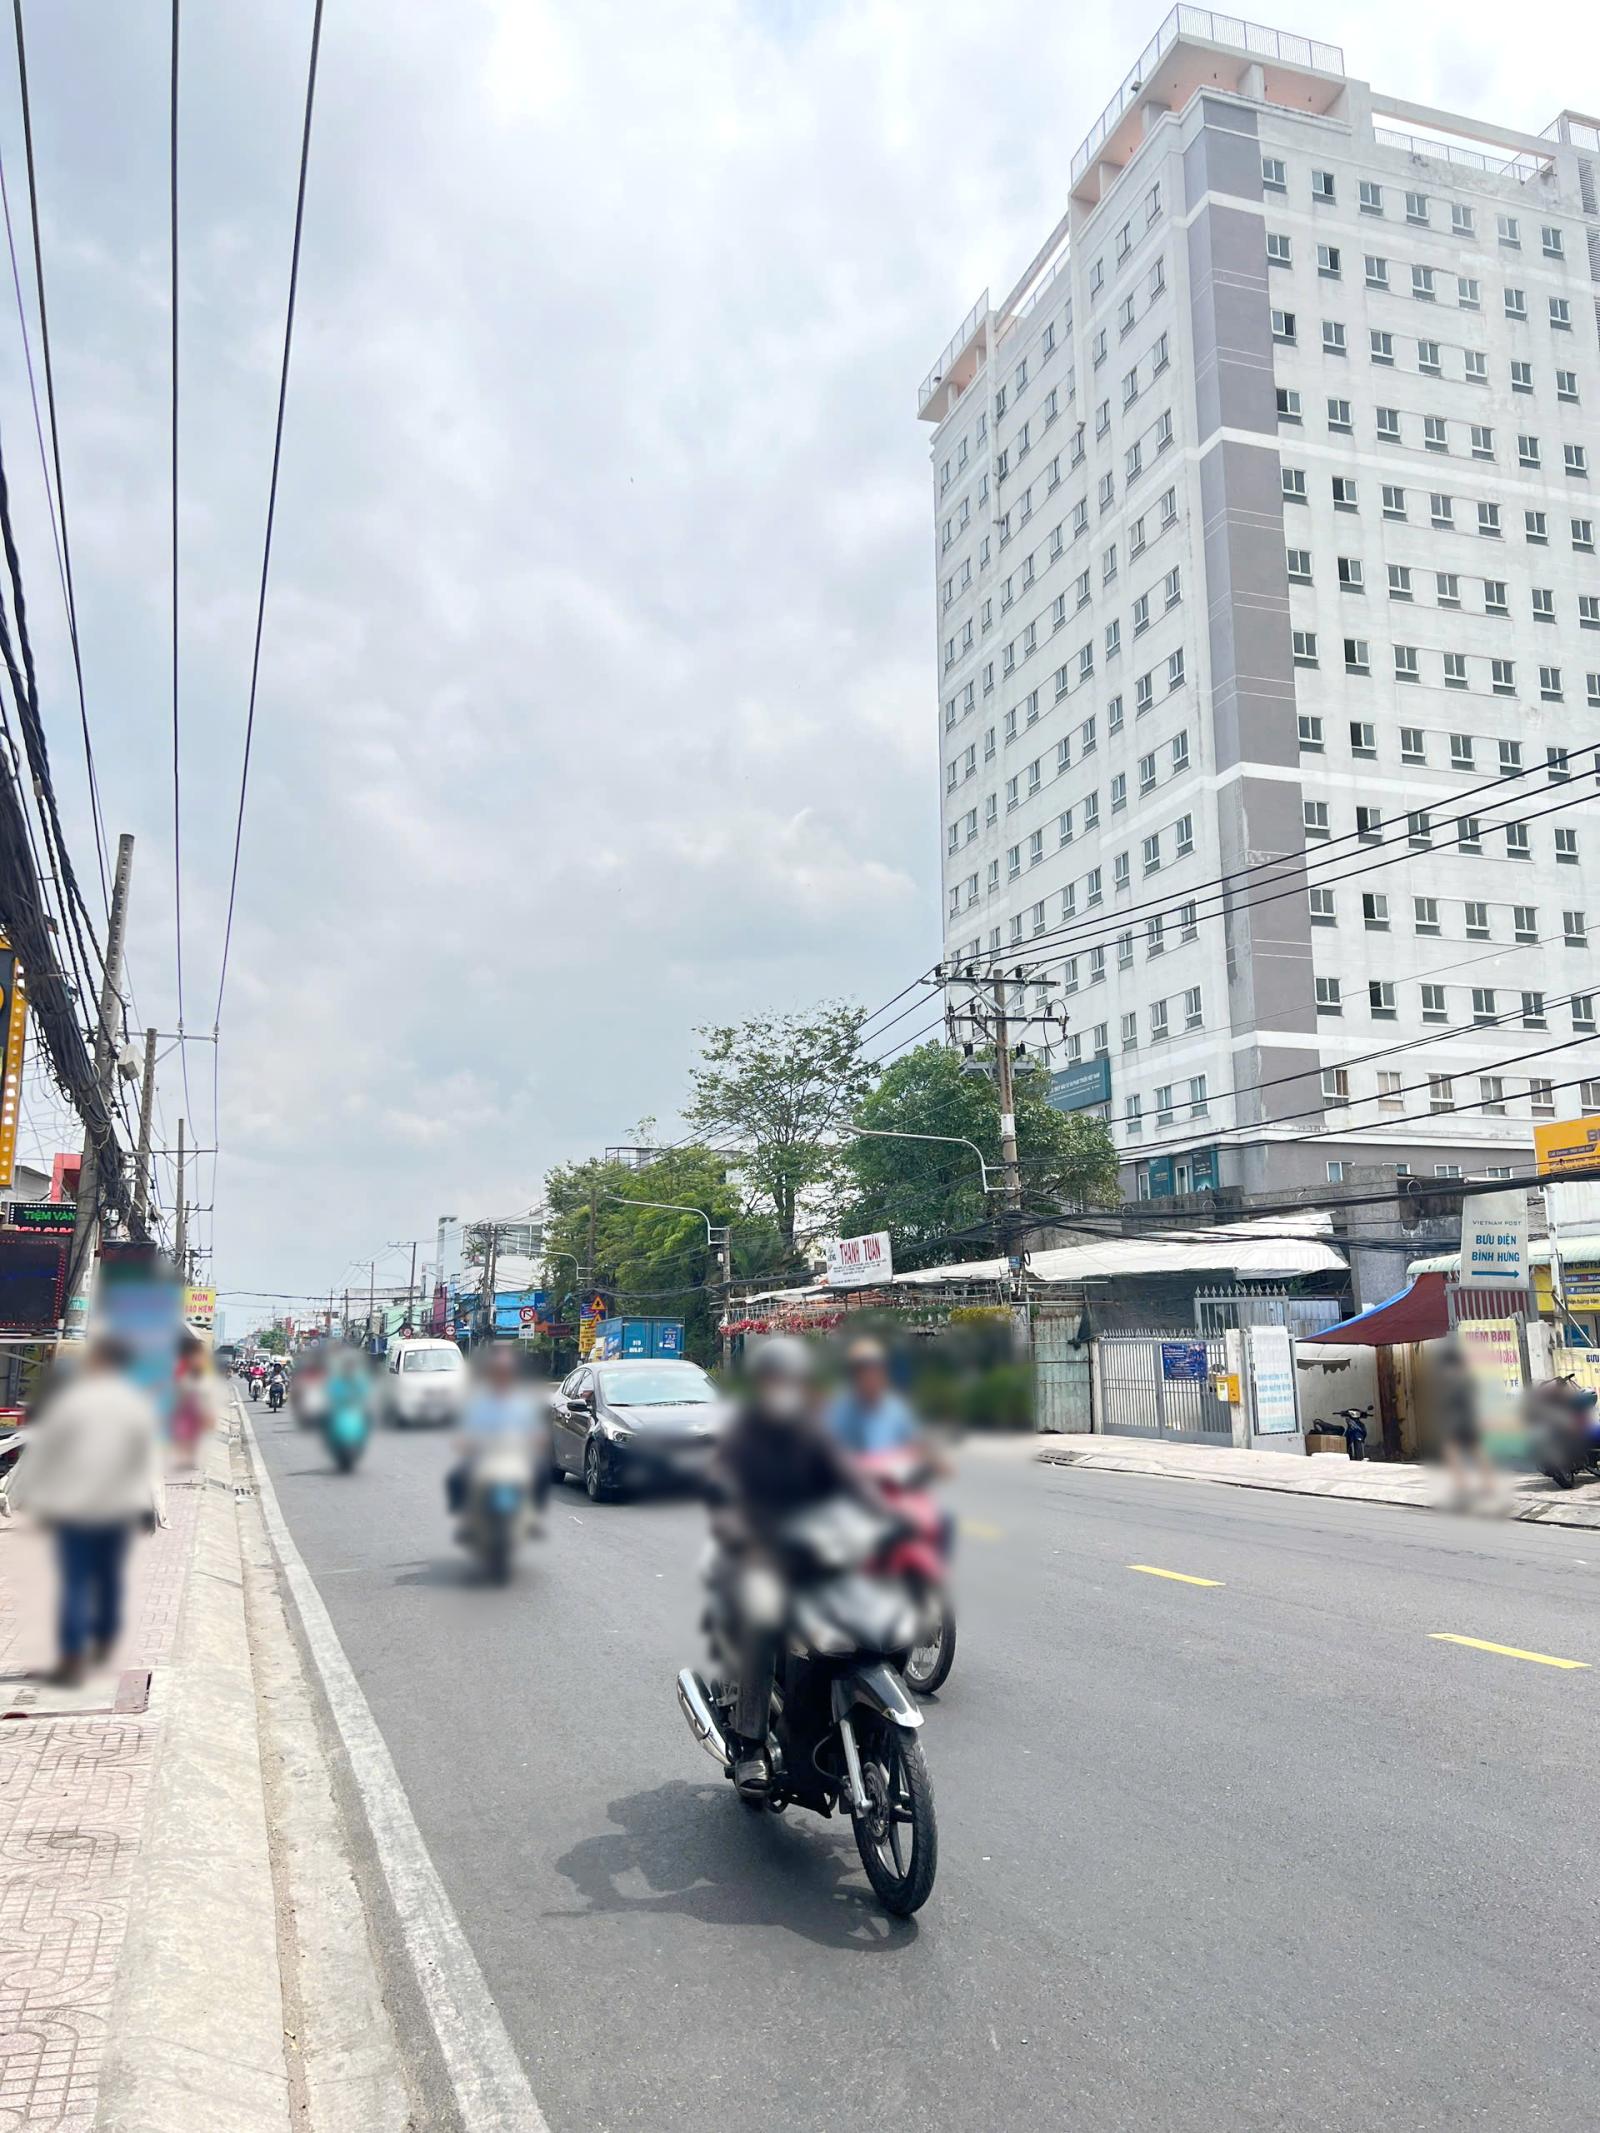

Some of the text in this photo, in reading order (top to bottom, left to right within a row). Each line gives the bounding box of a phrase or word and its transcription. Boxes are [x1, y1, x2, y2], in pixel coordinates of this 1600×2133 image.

[1475, 1233, 1517, 1246] BƯU ĐIỆN
[1471, 1249, 1520, 1262] BÌNH HƯNG
